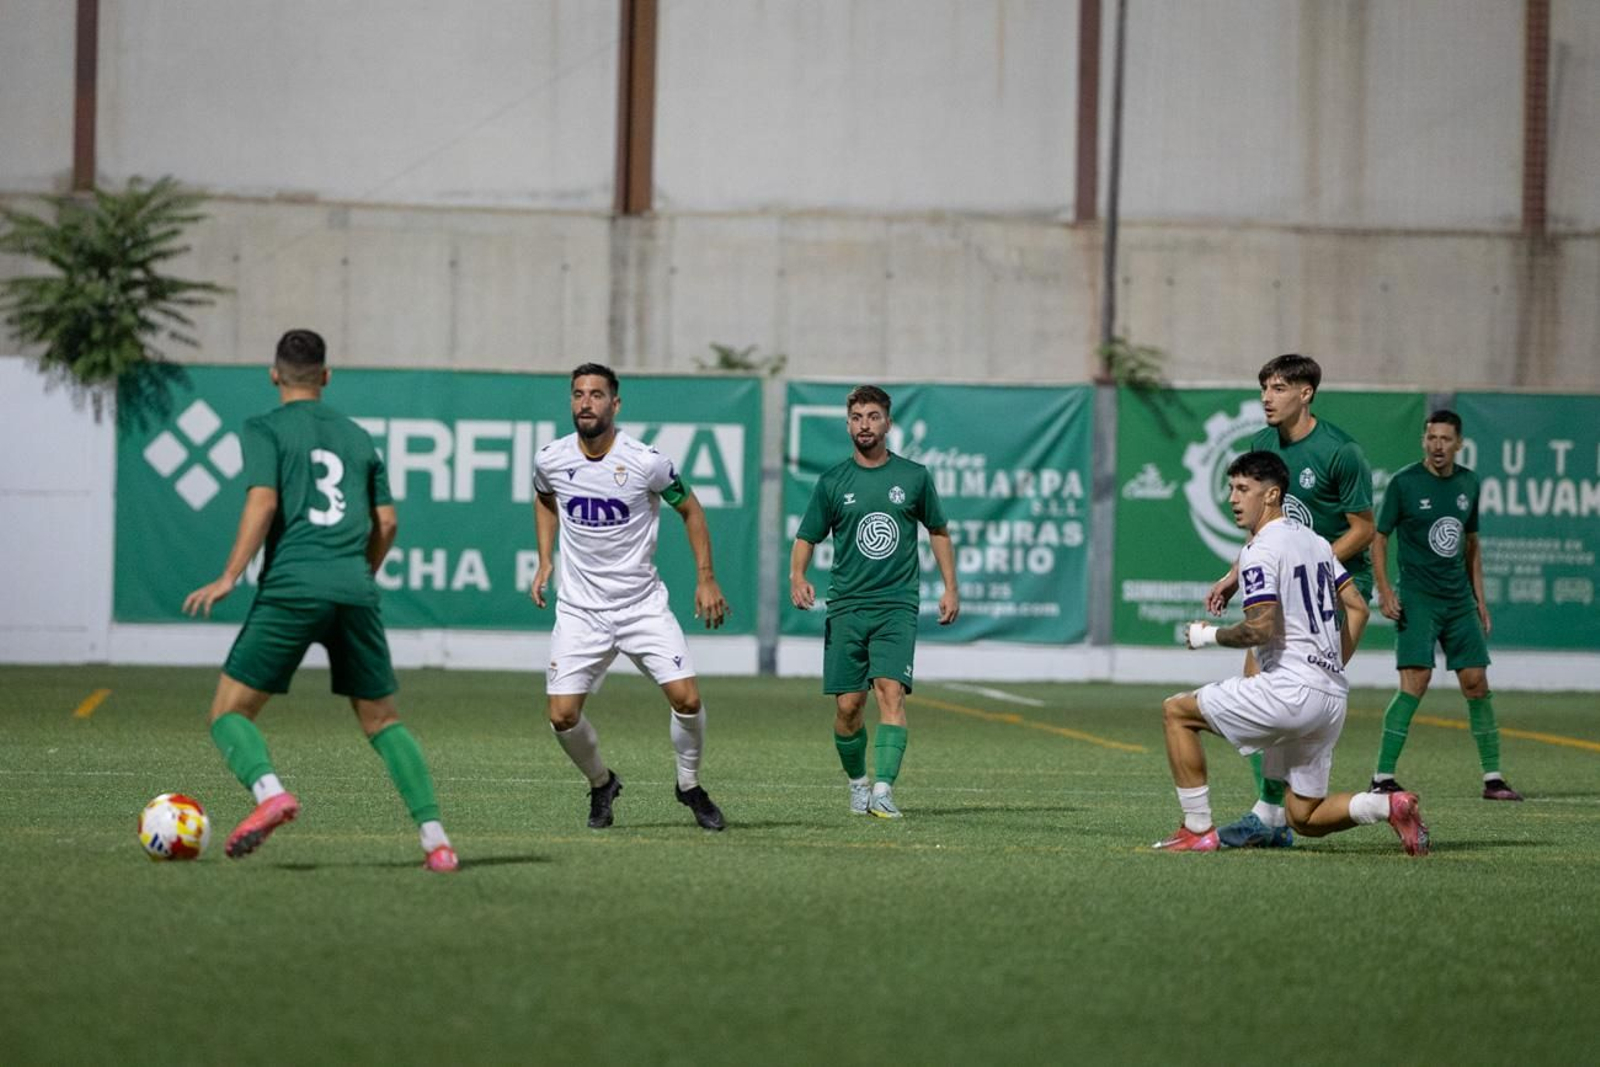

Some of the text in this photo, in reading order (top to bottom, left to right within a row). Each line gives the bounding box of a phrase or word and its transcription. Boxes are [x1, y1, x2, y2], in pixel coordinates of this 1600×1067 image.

[308, 449, 346, 526] 3
[935, 468, 1084, 498] UMARPA
[1293, 561, 1341, 635] 14
